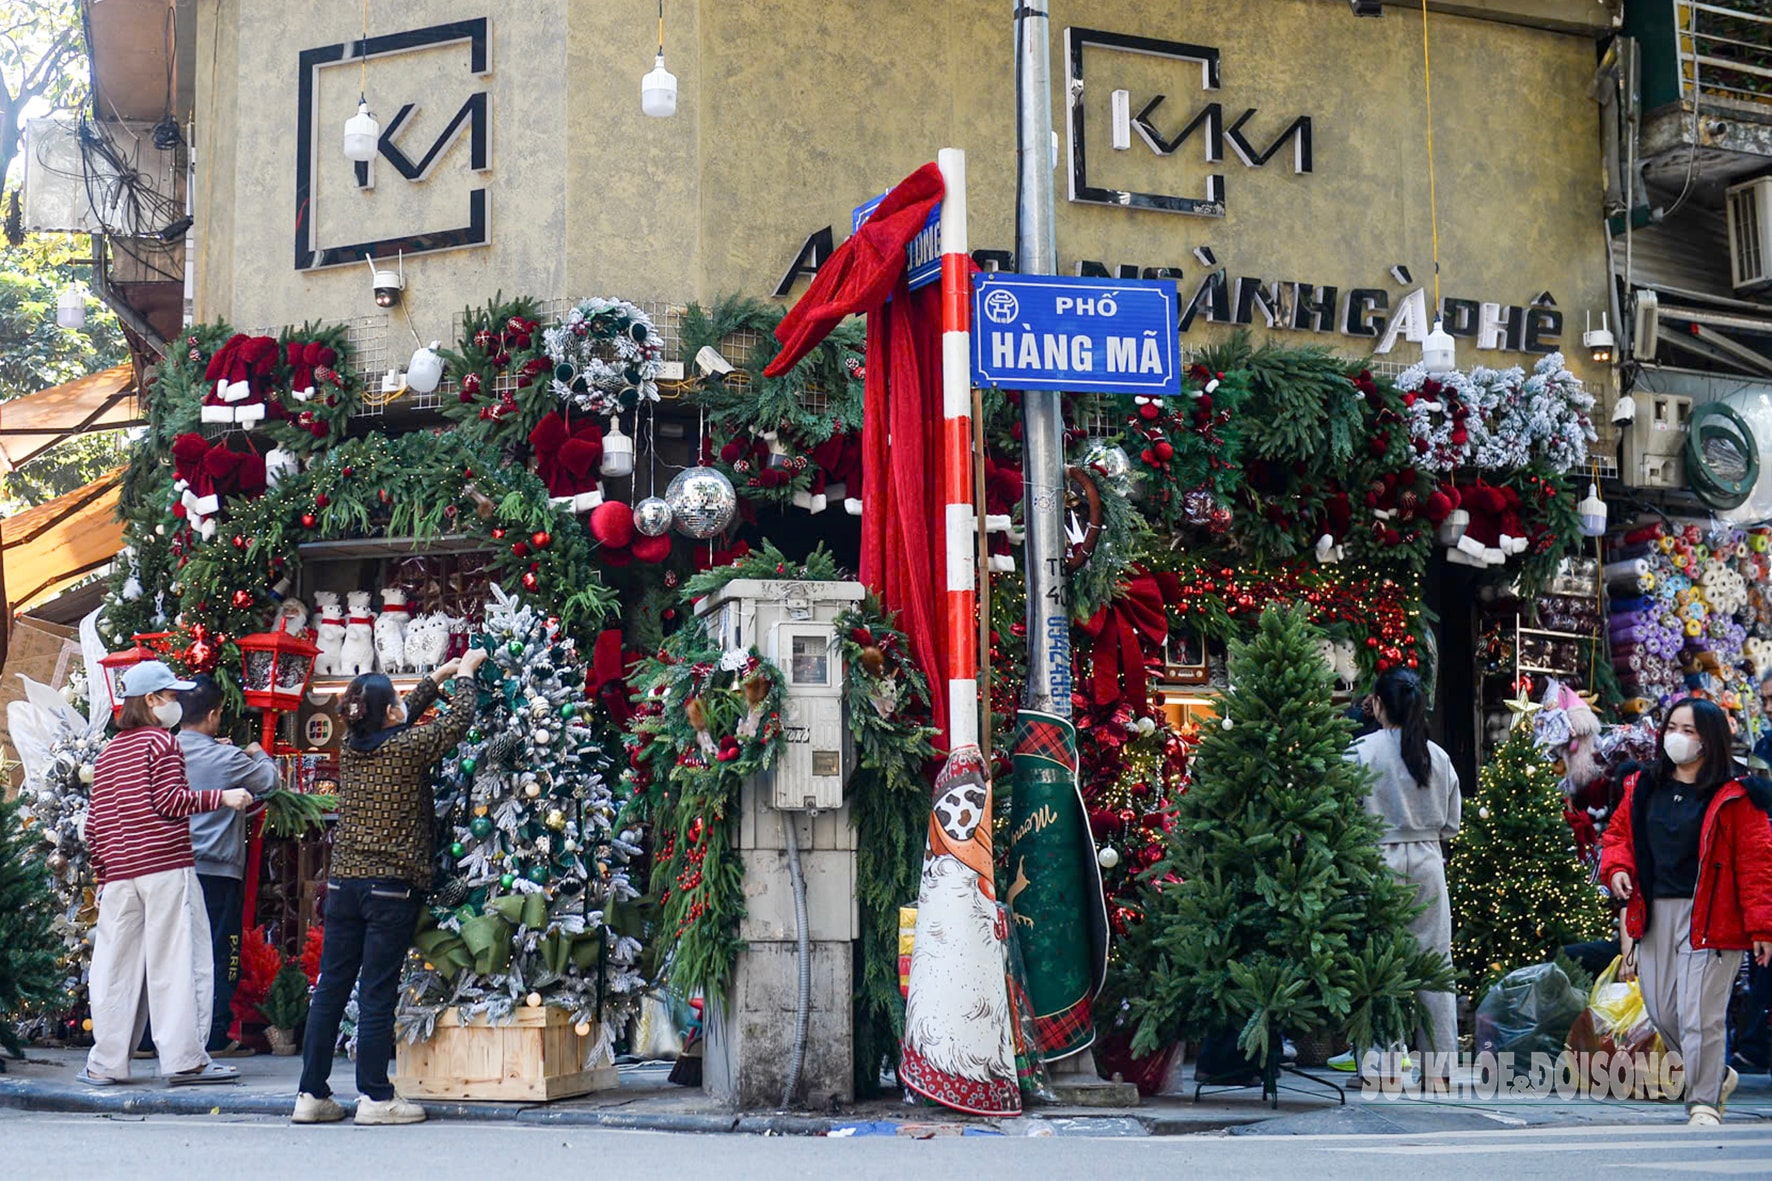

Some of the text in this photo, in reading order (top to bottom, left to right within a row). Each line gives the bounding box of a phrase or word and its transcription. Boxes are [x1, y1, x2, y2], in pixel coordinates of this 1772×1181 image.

[1056, 291, 1120, 317] PHỐ
[991, 322, 1164, 375] HÀNG MÃ
[228, 934, 239, 982] PARIS
